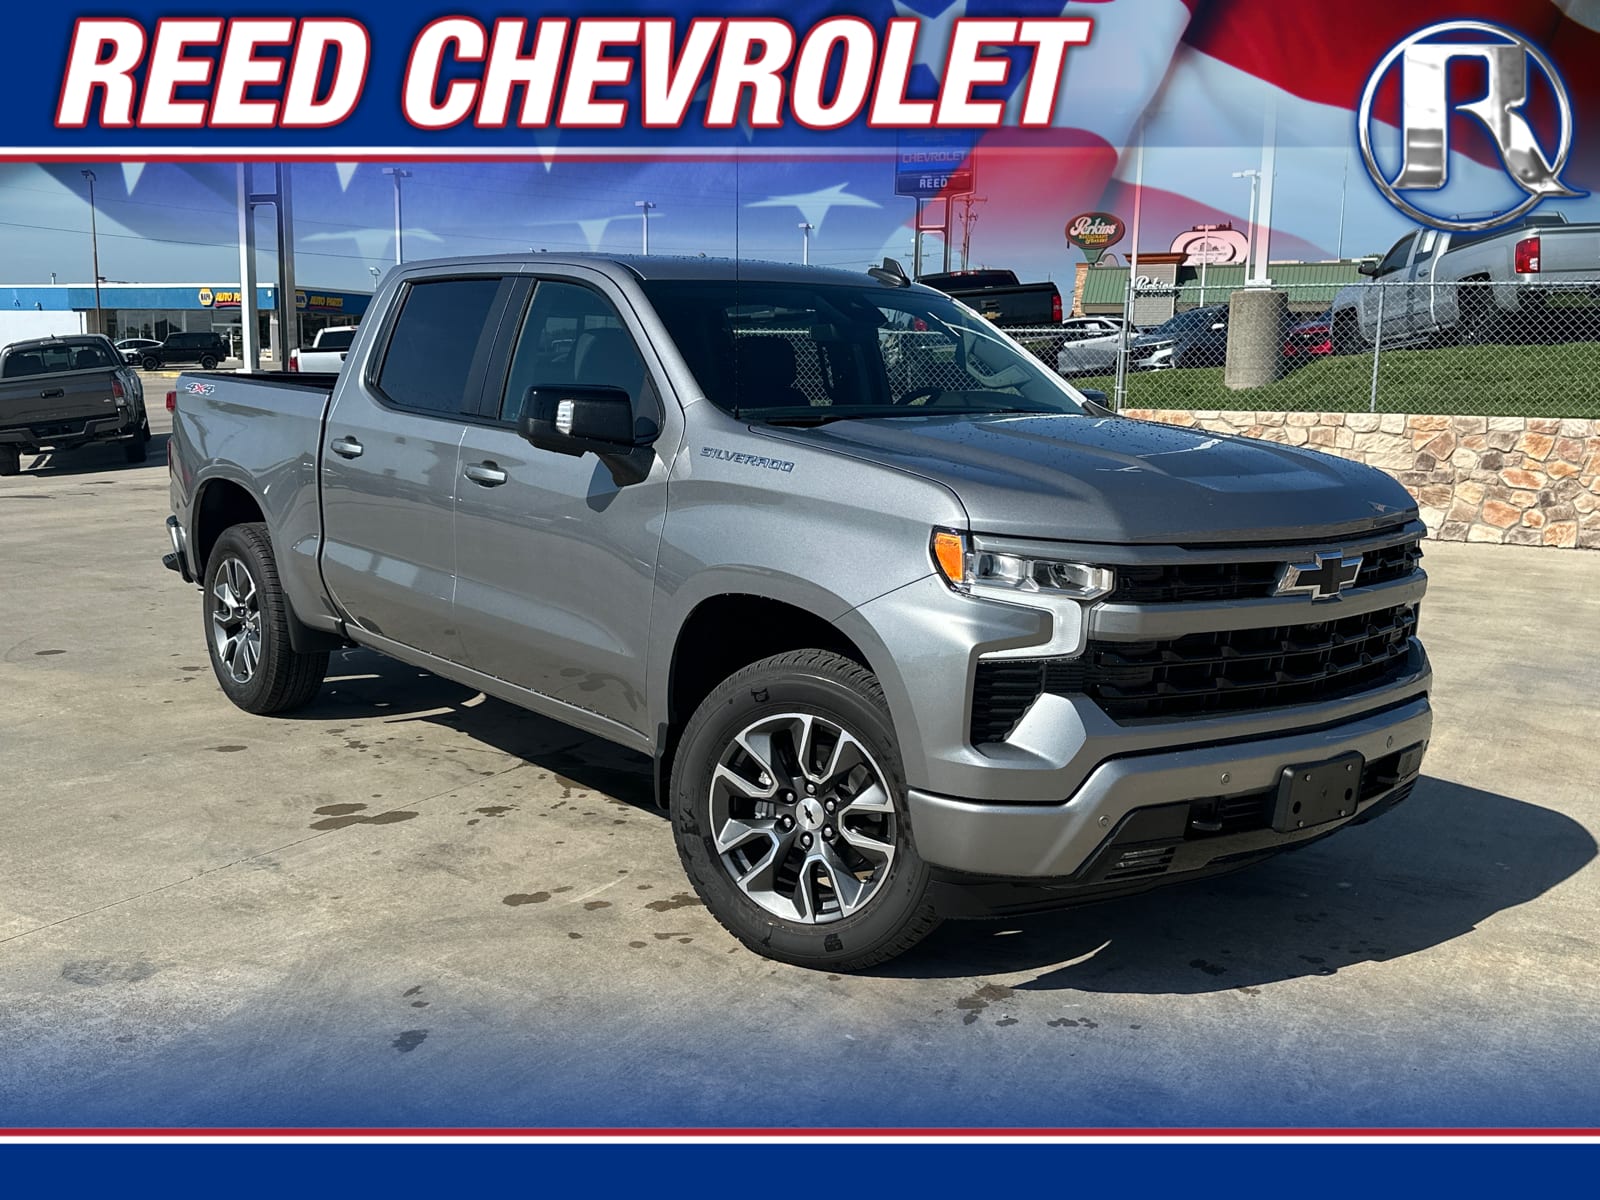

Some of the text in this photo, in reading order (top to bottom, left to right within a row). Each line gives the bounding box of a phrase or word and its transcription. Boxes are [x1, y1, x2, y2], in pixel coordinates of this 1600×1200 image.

[902, 151, 966, 163] CHEVROLET
[919, 178, 948, 189] REED
[1069, 216, 1117, 236] Perkins
[215, 292, 233, 302] AUTO
[310, 295, 326, 305] AUTO
[700, 446, 795, 473] SILVERADO
